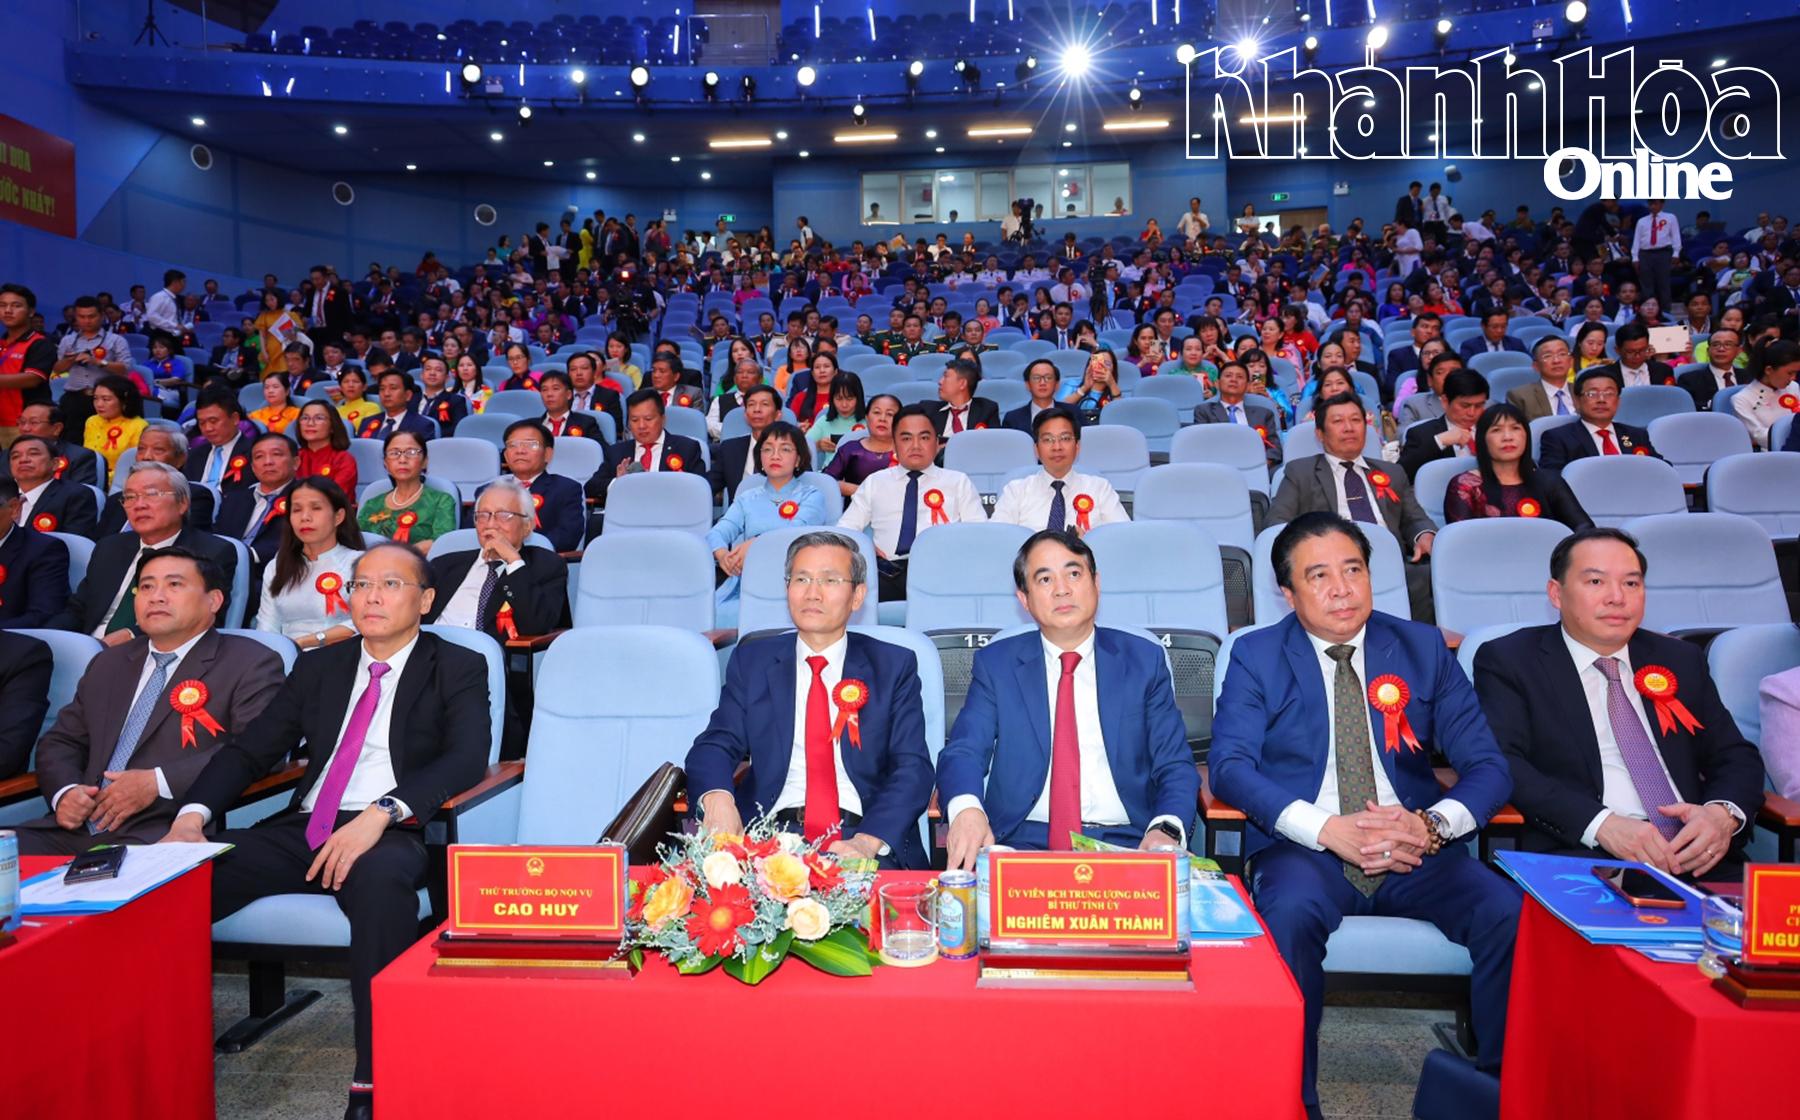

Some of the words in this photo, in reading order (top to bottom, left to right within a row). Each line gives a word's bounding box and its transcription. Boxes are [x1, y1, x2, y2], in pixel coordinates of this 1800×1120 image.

[982, 495, 997, 505] 16
[964, 633, 989, 648] 15
[1161, 633, 1172, 648] 4
[544, 887, 558, 898] BỘ
[578, 888, 593, 898] VỤ
[1023, 887, 1045, 898] VIÊN
[1048, 889, 1067, 899] BCH
[1069, 889, 1101, 899] TRUNG
[493, 902, 533, 916] CAO
[540, 903, 579, 916] HUY
[1060, 900, 1080, 910] THƯ
[1006, 913, 1065, 929] NGHIÊM
[1069, 914, 1109, 930] XUÂN
[1113, 914, 1164, 931] THÀNH
[1763, 932, 1800, 947] NGU
